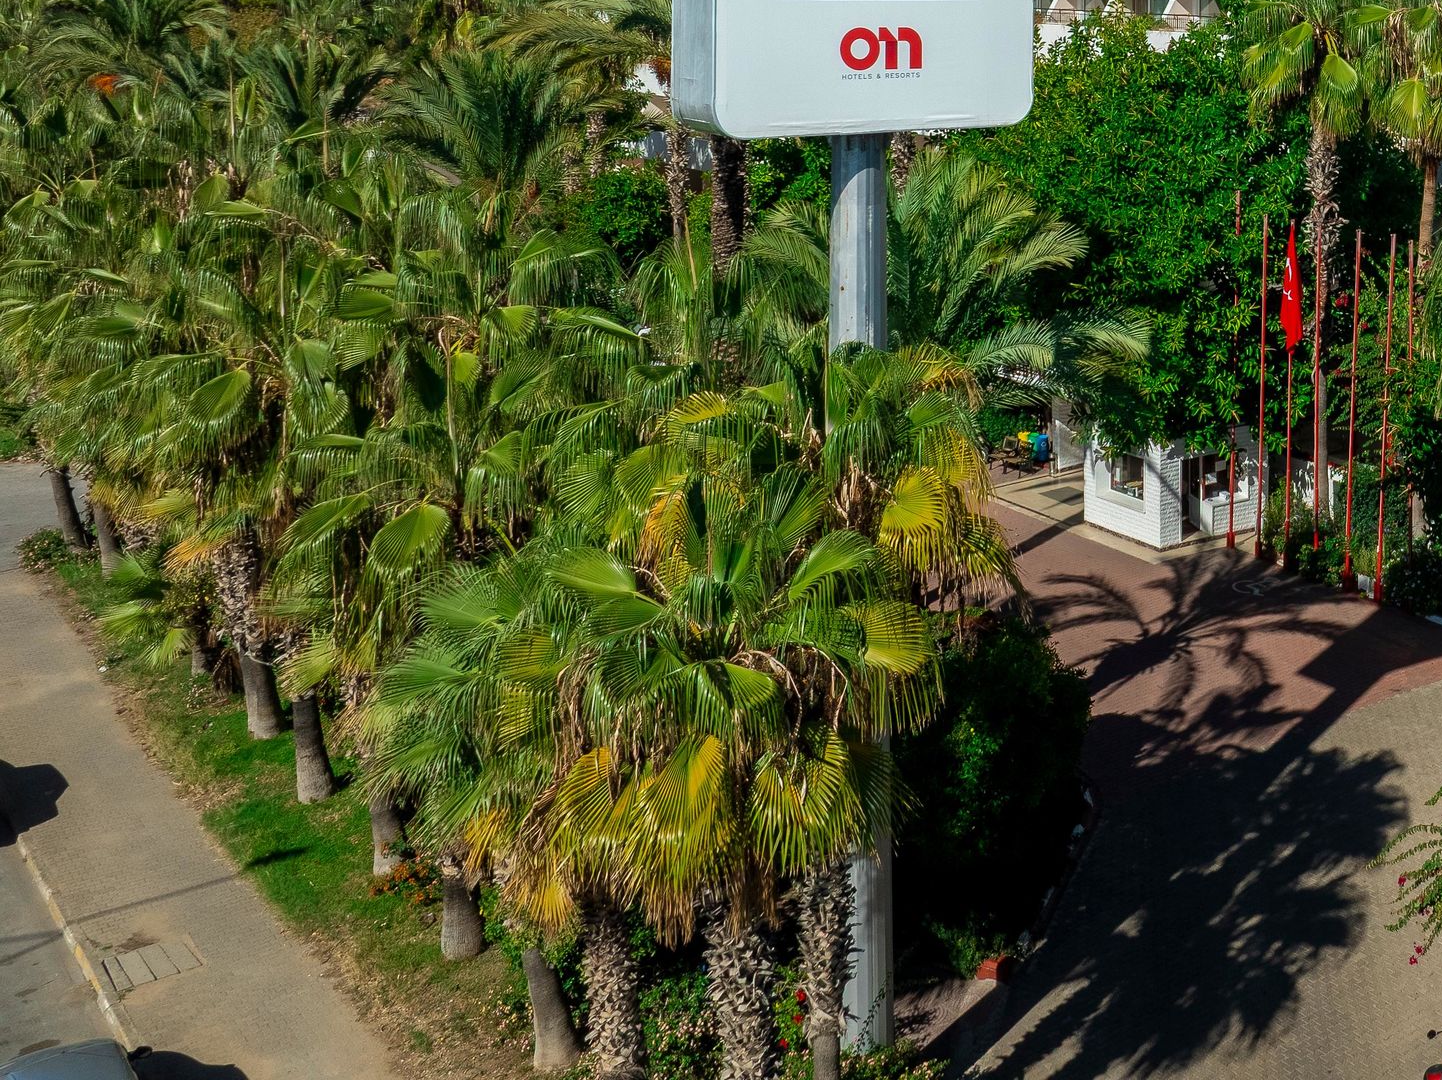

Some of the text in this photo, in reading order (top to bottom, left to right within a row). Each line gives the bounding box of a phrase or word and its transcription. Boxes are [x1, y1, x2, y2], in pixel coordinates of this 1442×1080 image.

[841, 71, 921, 80] HOTELS & RESORTS
